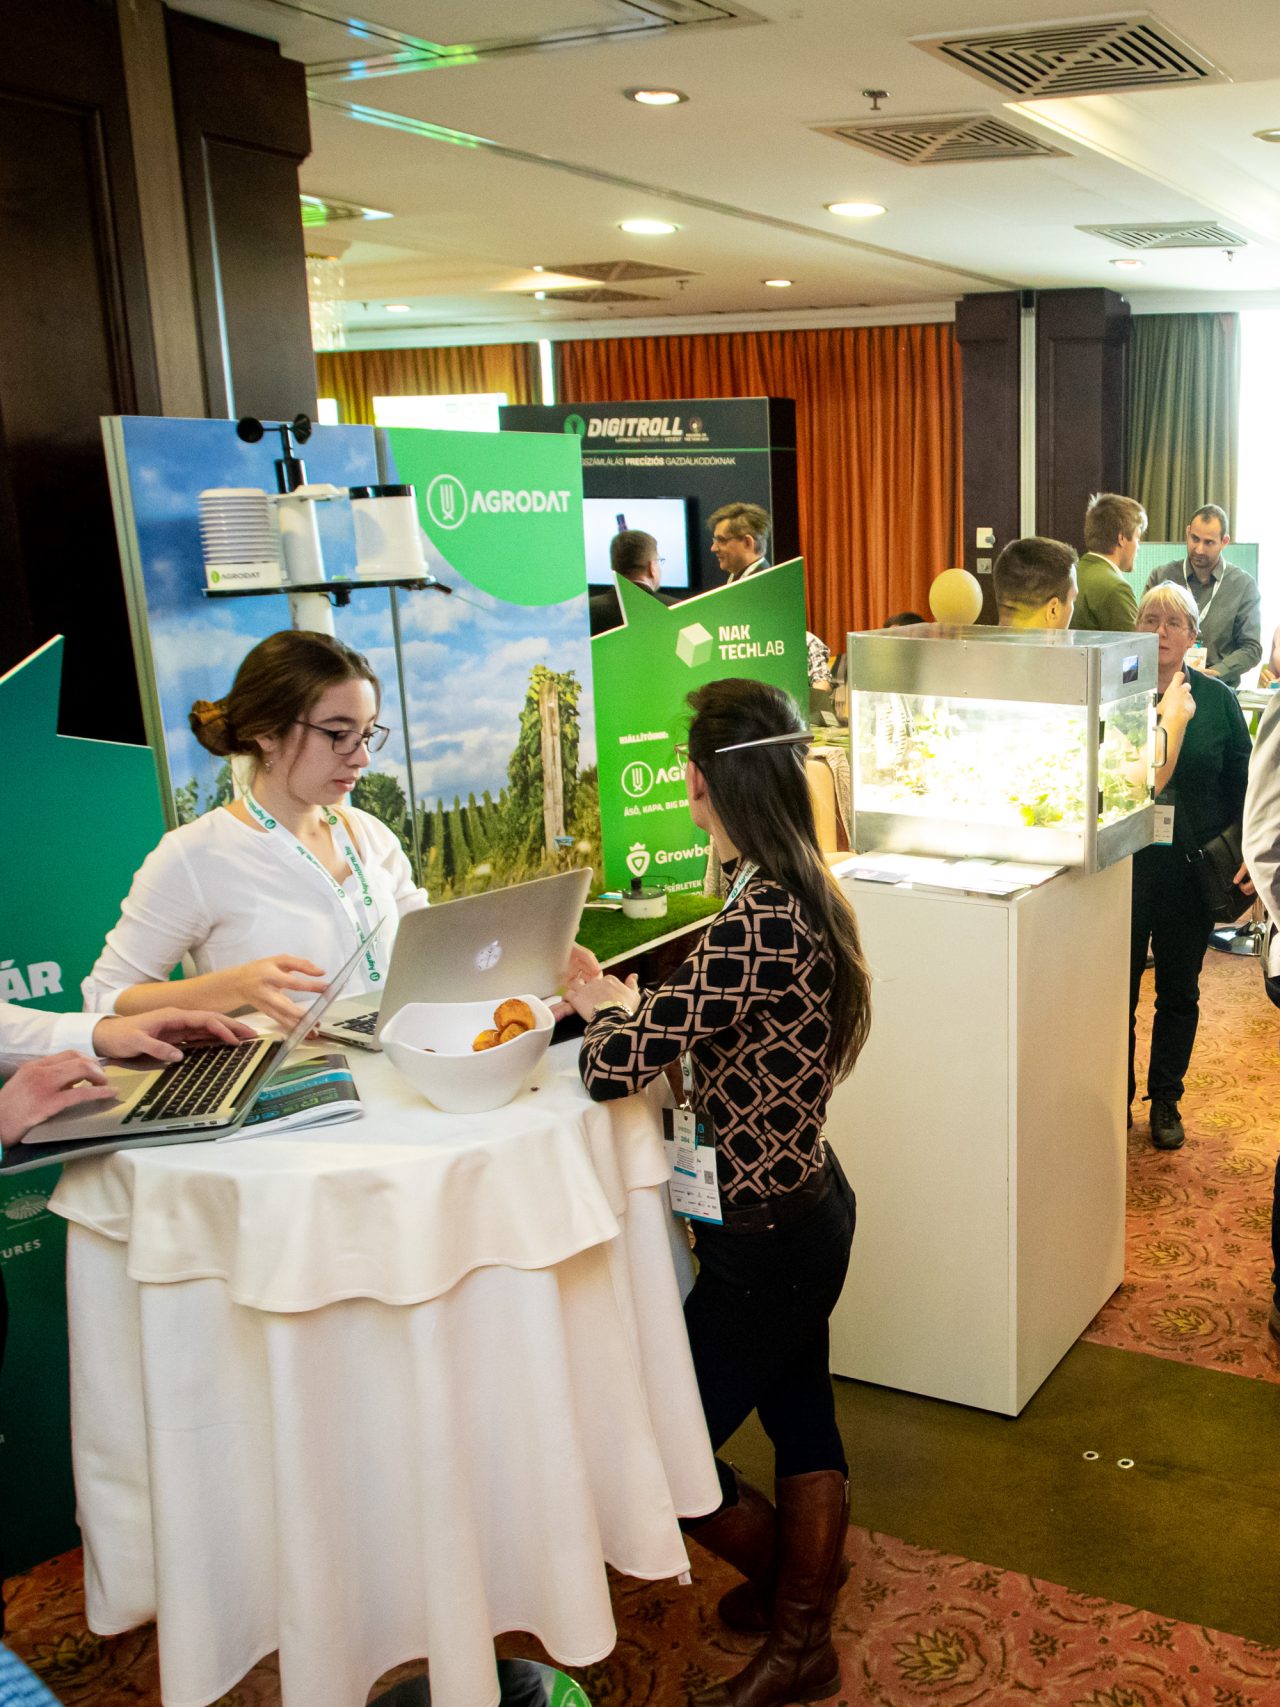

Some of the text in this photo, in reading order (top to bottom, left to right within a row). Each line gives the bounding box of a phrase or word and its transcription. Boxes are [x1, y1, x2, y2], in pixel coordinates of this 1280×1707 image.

[587, 416, 683, 437] DIGITROLL
[625, 456, 665, 466] PRECÍZIÓS
[471, 490, 571, 513] AGRODAT
[718, 625, 751, 642] NAK
[718, 640, 785, 661] TECHLAB
[664, 879, 702, 893] SÉRLETEK
[0, 1239, 41, 1259] URES
